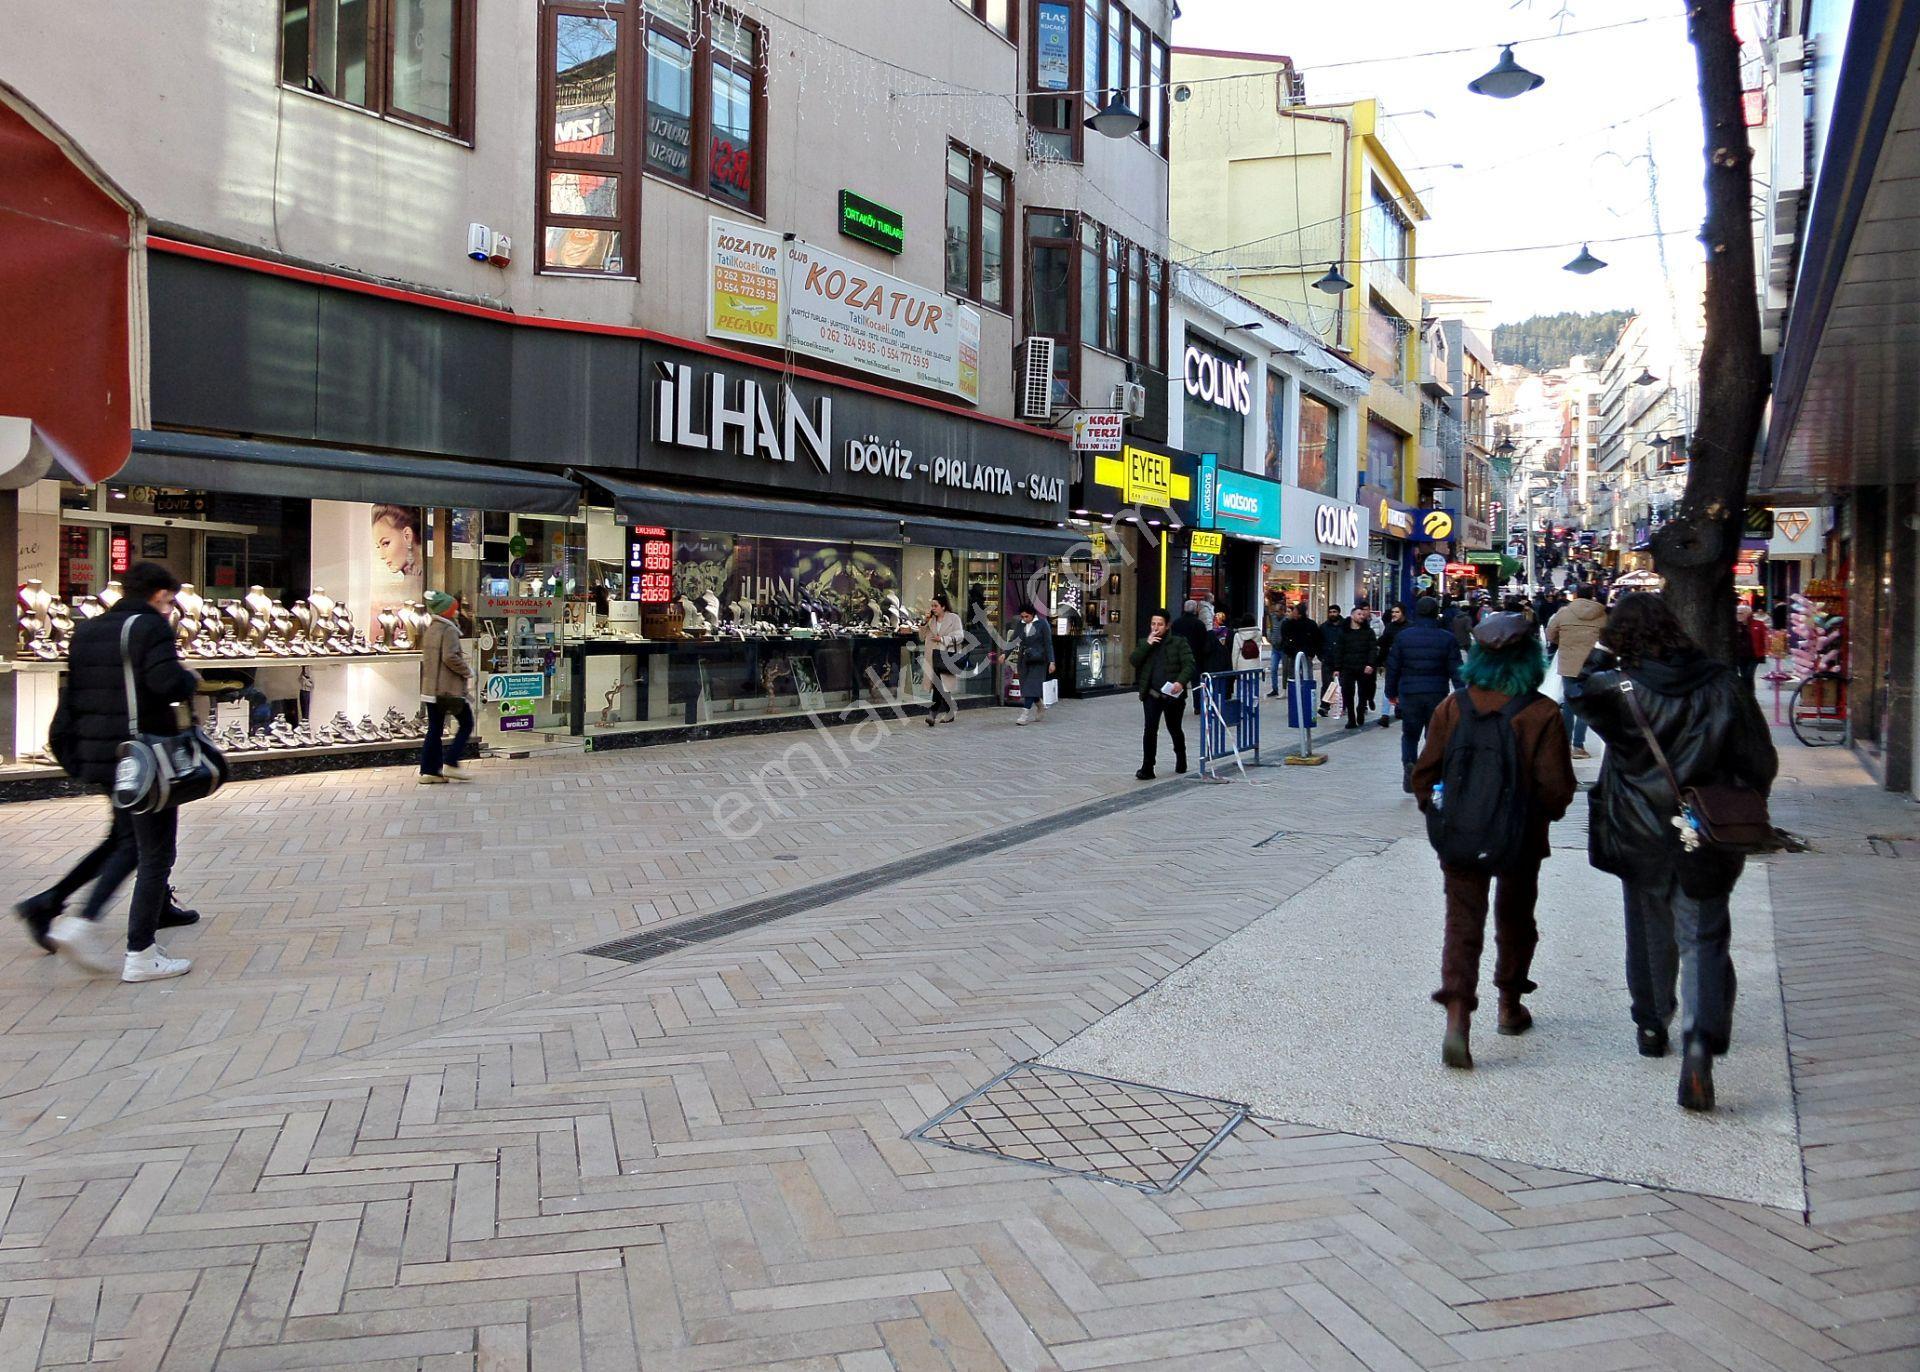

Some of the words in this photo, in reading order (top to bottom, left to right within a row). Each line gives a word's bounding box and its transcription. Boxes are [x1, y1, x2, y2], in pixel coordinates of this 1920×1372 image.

[846, 207, 876, 229] ORTAKÖY
[717, 234, 778, 261] KOZATUR
[788, 248, 808, 265] CLUB
[717, 253, 777, 277] TatilKocaeli.com
[717, 269, 723, 278] 0
[724, 271, 738, 281] 262
[741, 274, 755, 285] 324
[756, 278, 766, 288] 59
[767, 280, 777, 290] 95
[717, 281, 722, 290] 0
[723, 282, 739, 294] 554
[741, 286, 755, 297] 772
[756, 289, 766, 299] 59
[767, 292, 777, 302] 59
[804, 261, 943, 335] KOZATUR
[717, 314, 776, 338] PEGASUS
[849, 310, 906, 339] TatilKocaeli.com
[820, 326, 826, 338] 0
[827, 328, 840, 343] 262
[843, 333, 856, 348] 324
[857, 338, 867, 351] 59
[867, 342, 876, 354] 95
[881, 345, 886, 358] 0
[887, 347, 899, 361] 554
[900, 351, 912, 365] 772
[912, 354, 921, 367] 59
[921, 357, 930, 369] 59
[1184, 346, 1251, 416] COLIN'S
[651, 361, 832, 475] İLHAN
[1089, 415, 1120, 425] KRAL
[1087, 427, 1121, 438] TERZİ
[846, 434, 912, 480] DÖVİZ
[931, 456, 1013, 496] PIRLANTA
[1028, 473, 1065, 504] SAAT
[1132, 453, 1168, 487] EYFEL
[1203, 472, 1212, 513] watsons
[1222, 491, 1258, 514] watsons
[1315, 504, 1359, 549] COLIN'S
[1192, 534, 1220, 547] EYFEL
[1275, 553, 1315, 565] COLIN'S
